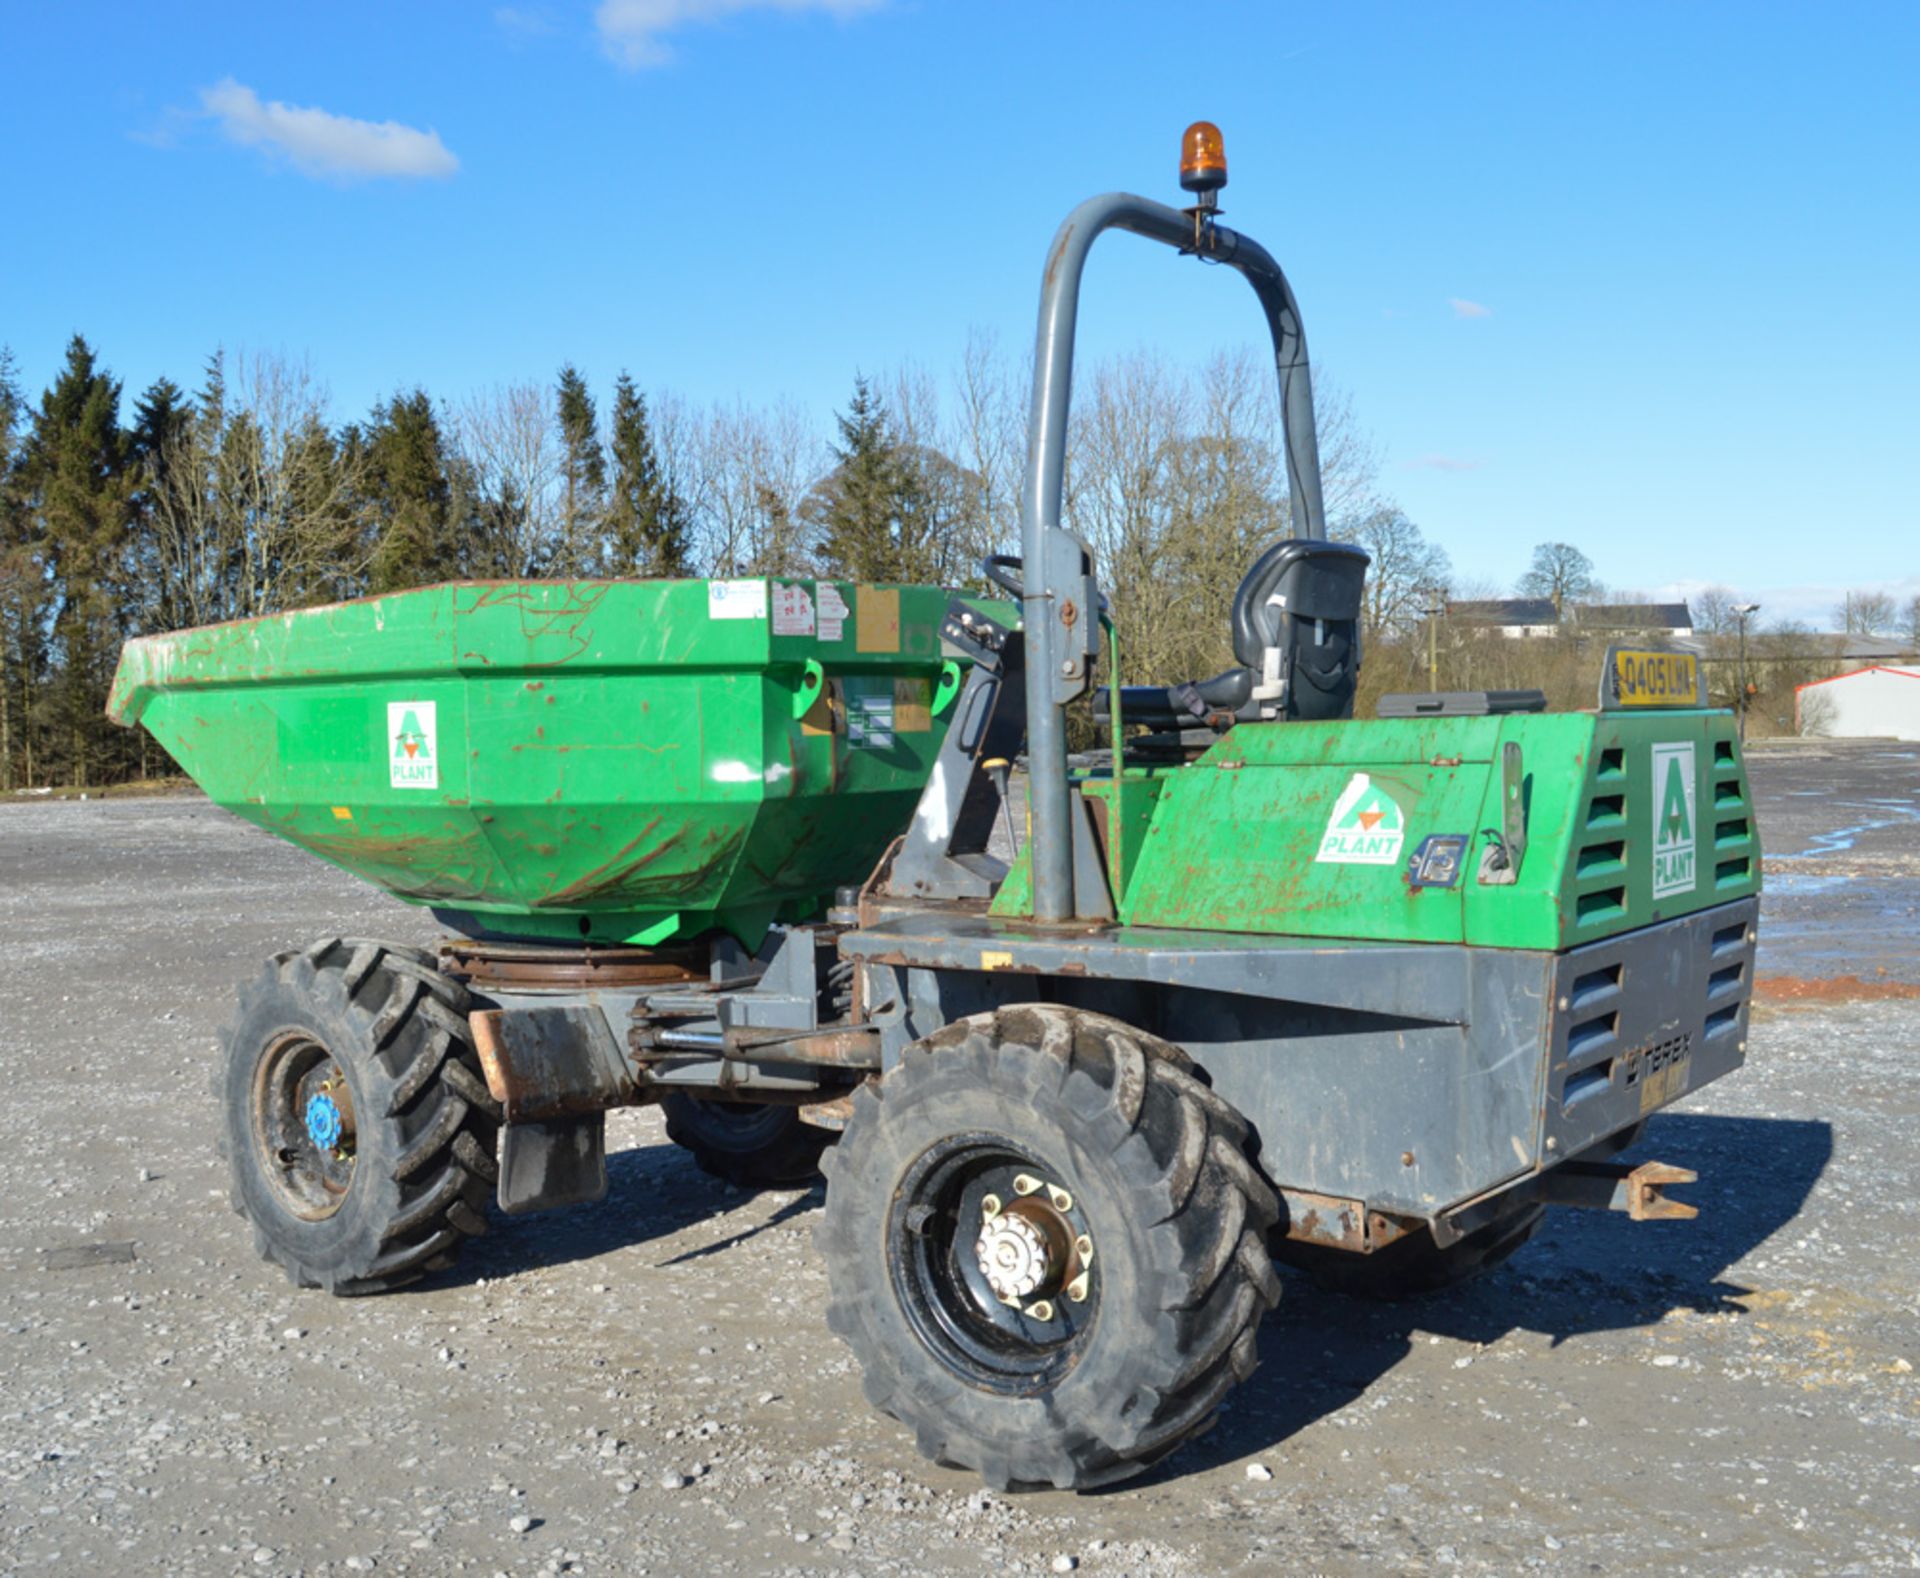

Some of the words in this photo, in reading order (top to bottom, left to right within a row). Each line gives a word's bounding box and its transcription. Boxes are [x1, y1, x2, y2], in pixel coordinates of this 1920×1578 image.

[395, 709, 431, 758] A
[393, 765, 434, 779] PLANT
[1337, 783, 1399, 829] A
[1657, 757, 1691, 845] A
[1323, 836, 1399, 855] PLANT
[1655, 851, 1694, 887] PLANT
[1643, 1030, 1693, 1078] TEREX
